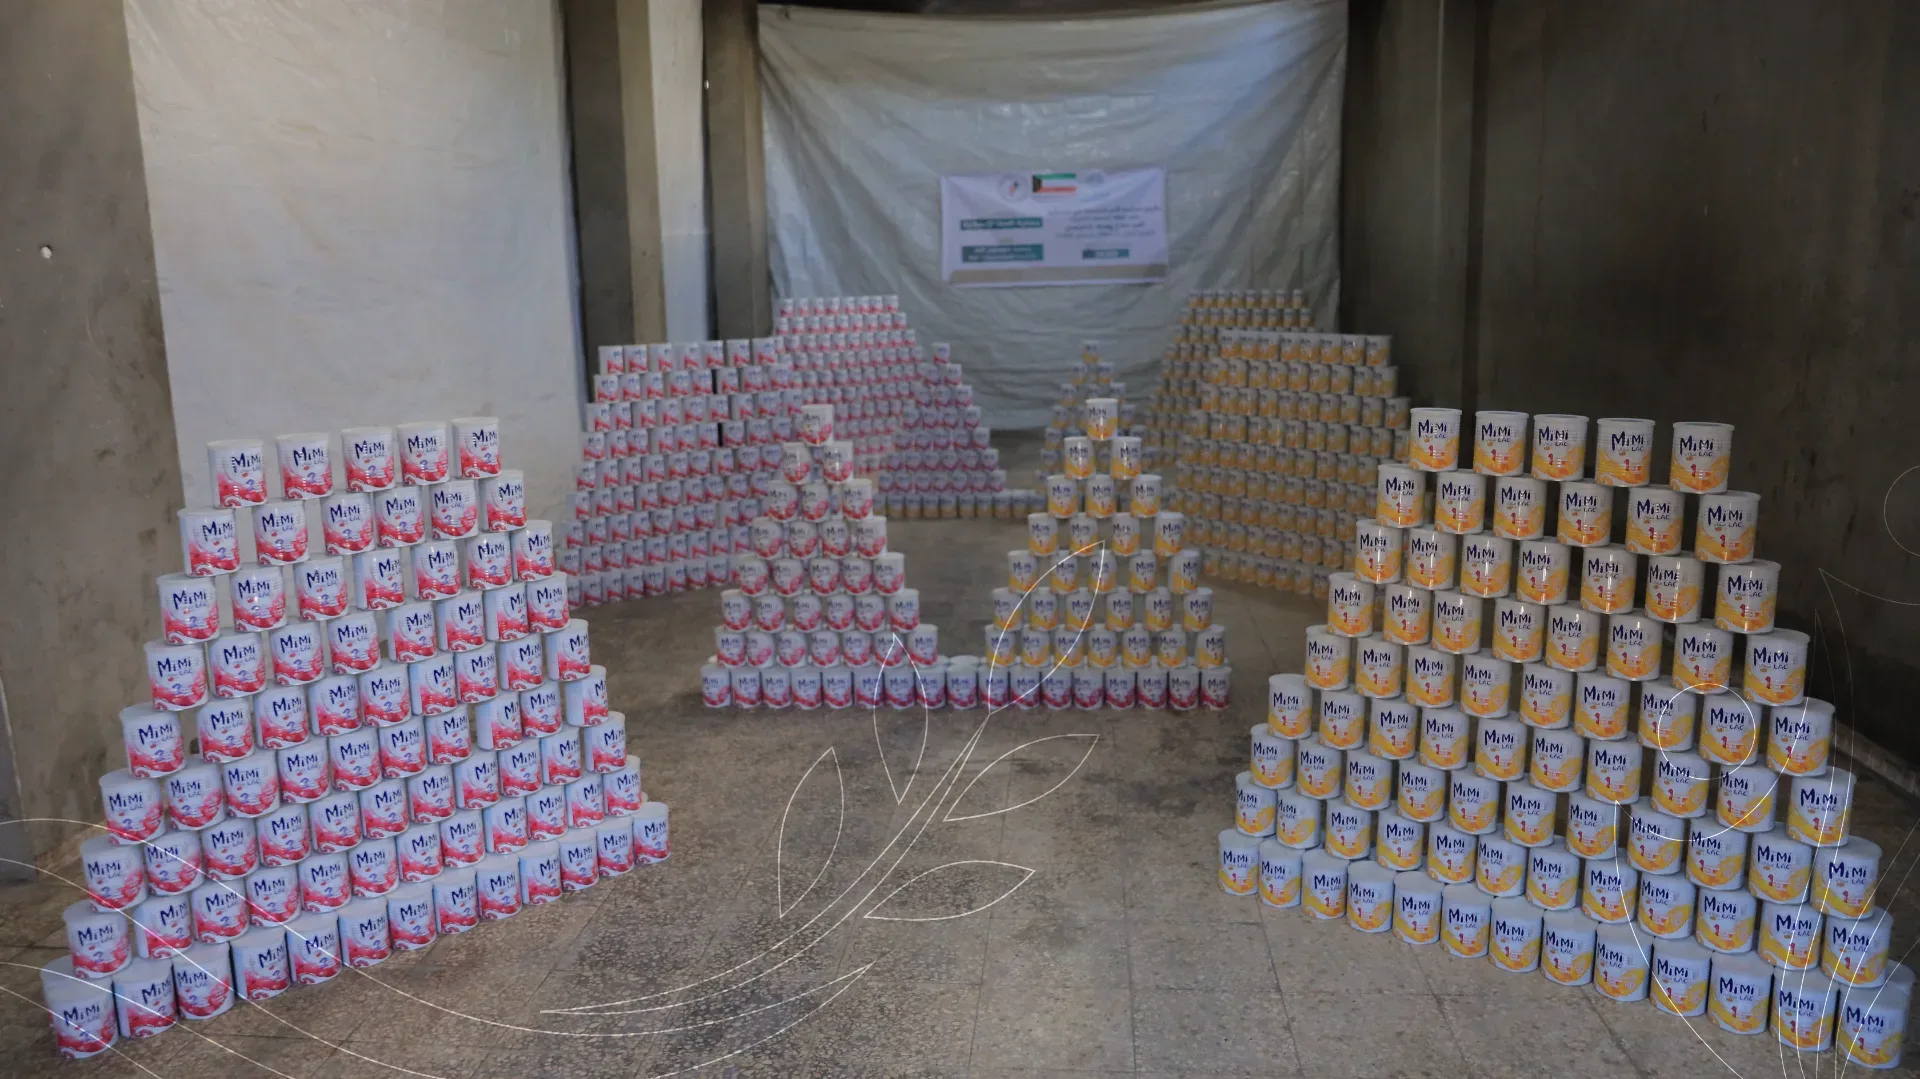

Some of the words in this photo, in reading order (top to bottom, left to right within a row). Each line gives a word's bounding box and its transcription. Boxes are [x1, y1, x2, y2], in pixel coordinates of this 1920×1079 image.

[1481, 423, 1510, 442] MiMi
[1539, 427, 1568, 444] MiMi
[408, 436, 436, 453] MiMi
[1612, 432, 1644, 451] MiMi
[294, 447, 323, 466] MiMi
[355, 441, 385, 459] MiMi
[485, 453, 491, 463] 2
[1429, 445, 1433, 456] 1
[369, 466, 376, 476] 2
[1692, 464, 1696, 477] 1
[246, 480, 254, 490] 2
[1386, 477, 1414, 495] MiMi
[1442, 482, 1470, 501] MiMi
[386, 498, 415, 515] MiMi
[435, 492, 461, 508] MiMi
[1566, 493, 1596, 510] MiMi
[331, 504, 360, 523] MiMi
[1637, 499, 1670, 518] MiMi
[1708, 506, 1742, 525] MiMi
[262, 513, 293, 531] MiMi
[343, 529, 352, 540] 2
[1649, 527, 1654, 539] 1
[218, 548, 226, 558] 2
[478, 543, 505, 559] MiMi
[1412, 538, 1437, 555] MiMi
[1522, 551, 1550, 567] MiMi
[1589, 558, 1618, 576] MiMi
[307, 570, 337, 588] MiMi
[1531, 577, 1535, 588] 1
[238, 580, 270, 598] MiMi
[1335, 588, 1360, 603] MiMi
[173, 590, 206, 610] MiMi
[321, 594, 329, 606] 2
[1392, 595, 1419, 611] MiMi
[1343, 612, 1347, 623] 1
[1438, 601, 1463, 618] MiMi
[1502, 610, 1531, 626] MiMi
[1552, 617, 1581, 634] MiMi
[1613, 625, 1643, 641] MiMi
[281, 635, 311, 652] MiMi
[1309, 641, 1332, 655] MiMi
[1562, 644, 1566, 655] 1
[1683, 637, 1717, 655] MiMi
[224, 646, 255, 664] MiMi
[1754, 647, 1789, 665] MiMi
[158, 658, 190, 677] MiMi
[294, 660, 302, 670] 2
[1415, 658, 1443, 674] MiMi
[1465, 665, 1491, 681] MiMi
[239, 670, 247, 681] 2
[1766, 676, 1771, 689] 1
[371, 679, 400, 695] MiMi
[1584, 686, 1615, 703] MiMi
[273, 698, 301, 716] MiMi
[384, 702, 392, 712] 2
[530, 694, 556, 709] MiMi
[1325, 701, 1349, 715] MiMi
[1381, 711, 1408, 727] MiMi
[1711, 708, 1744, 725] MiMi
[287, 722, 295, 732] 2
[1427, 719, 1453, 734] MiMi
[1652, 722, 1657, 733] 1
[139, 725, 172, 745] MiMi
[392, 730, 419, 748] MiMi
[1485, 730, 1513, 746] MiMi
[341, 743, 369, 760] MiMi
[1254, 742, 1277, 756] MiMi
[1536, 738, 1562, 753] MiMi
[155, 750, 164, 761] 2
[288, 754, 318, 772] MiMi
[512, 752, 537, 768] MiMi
[1301, 751, 1324, 764] MiMi
[1495, 755, 1499, 766] 1
[1596, 750, 1626, 766] MiMi
[229, 768, 259, 785] MiMi
[301, 778, 309, 788] 2
[1402, 772, 1427, 786] MiMi
[171, 780, 200, 797] MiMi
[1453, 783, 1479, 798] MiMi
[1512, 795, 1540, 810] MiMi
[1801, 789, 1837, 806] MiMi
[1570, 805, 1597, 820] MiMi
[1728, 801, 1731, 812] 1
[124, 819, 132, 829] 2
[272, 817, 301, 835] MiMi
[1332, 812, 1357, 826] MiMi
[1387, 825, 1413, 838] MiMi
[1579, 831, 1582, 842] 1
[212, 831, 243, 849] MiMi
[604, 835, 627, 849] MiMi
[148, 845, 178, 862] MiMi
[226, 855, 235, 865] 2
[357, 851, 385, 867] MiMi
[569, 848, 592, 862] MiMi
[1224, 851, 1247, 864] MiMi
[1758, 845, 1791, 862] MiMi
[312, 865, 340, 882] MiMi
[1261, 861, 1285, 875] MiMi
[1533, 858, 1561, 873] MiMi
[1829, 862, 1866, 878] MiMi
[1314, 875, 1340, 889] MiMi
[1591, 871, 1621, 885] MiMi
[254, 879, 285, 896] MiMi
[1351, 884, 1374, 898] MiMi
[1542, 883, 1546, 894] 1
[1402, 897, 1430, 911] MiMi
[1704, 896, 1736, 913] MiMi
[1449, 909, 1477, 923] MiMi
[78, 926, 113, 946] MiMi
[1496, 921, 1524, 936] MiMi
[1460, 934, 1463, 944] 1
[1546, 932, 1573, 948] MiMi
[1598, 943, 1623, 962] MiMi
[1554, 958, 1558, 969] 1
[177, 971, 207, 987] MiMi
[1720, 977, 1754, 994] MiMi
